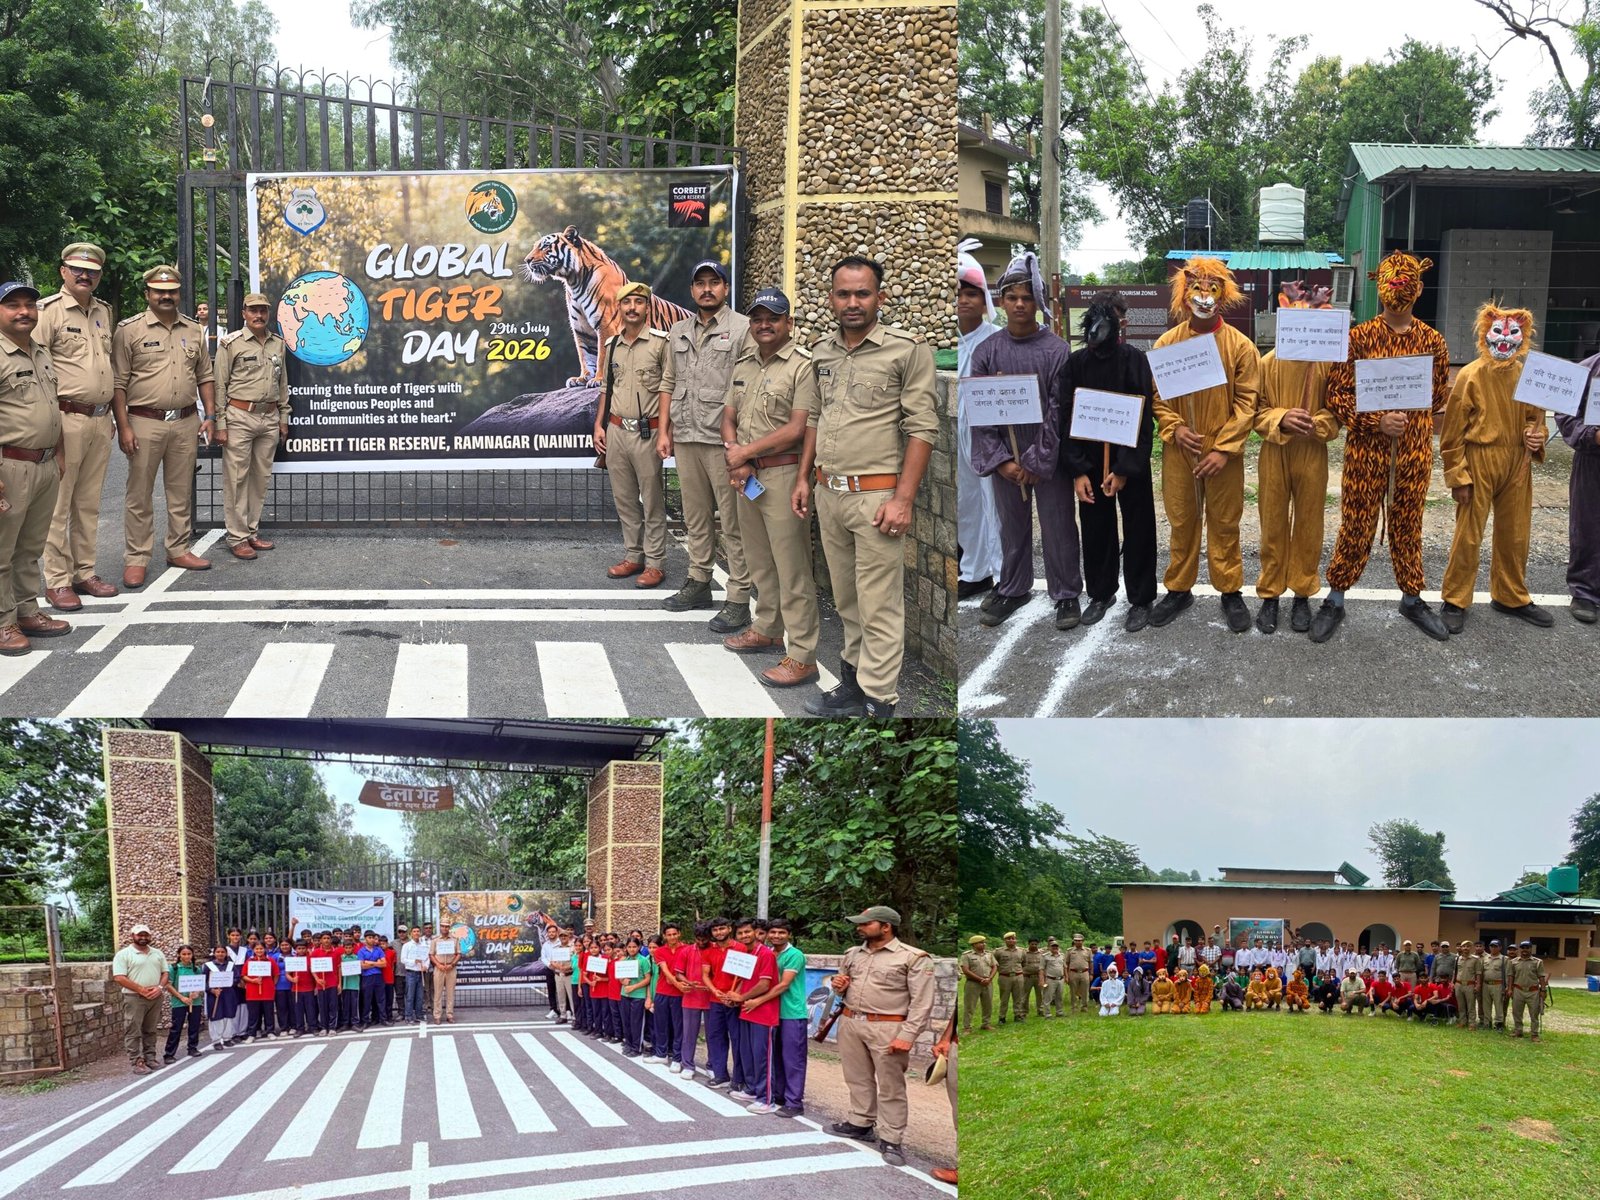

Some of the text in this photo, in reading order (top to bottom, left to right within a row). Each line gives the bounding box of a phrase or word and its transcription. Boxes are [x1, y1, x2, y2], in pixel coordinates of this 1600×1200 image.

[365, 242, 513, 278] GLOBAL
[378, 285, 503, 322] TIGER
[490, 322, 550, 336] 29th July
[402, 329, 479, 364] DAY
[487, 338, 551, 361] 2026
[288, 382, 462, 397] Securing the future of Tigers with
[310, 398, 434, 412] Indigenous Peoples and
[288, 412, 456, 425] Local Communities at the heart."
[286, 434, 593, 452] CORBETT TIGER RESERVE, RAMNAGAR (NAINITA
[378, 784, 440, 802] ढेला गेट
[474, 914, 521, 926] GLOBAL
[478, 927, 519, 940] TIGER
[486, 942, 511, 954] DAY
